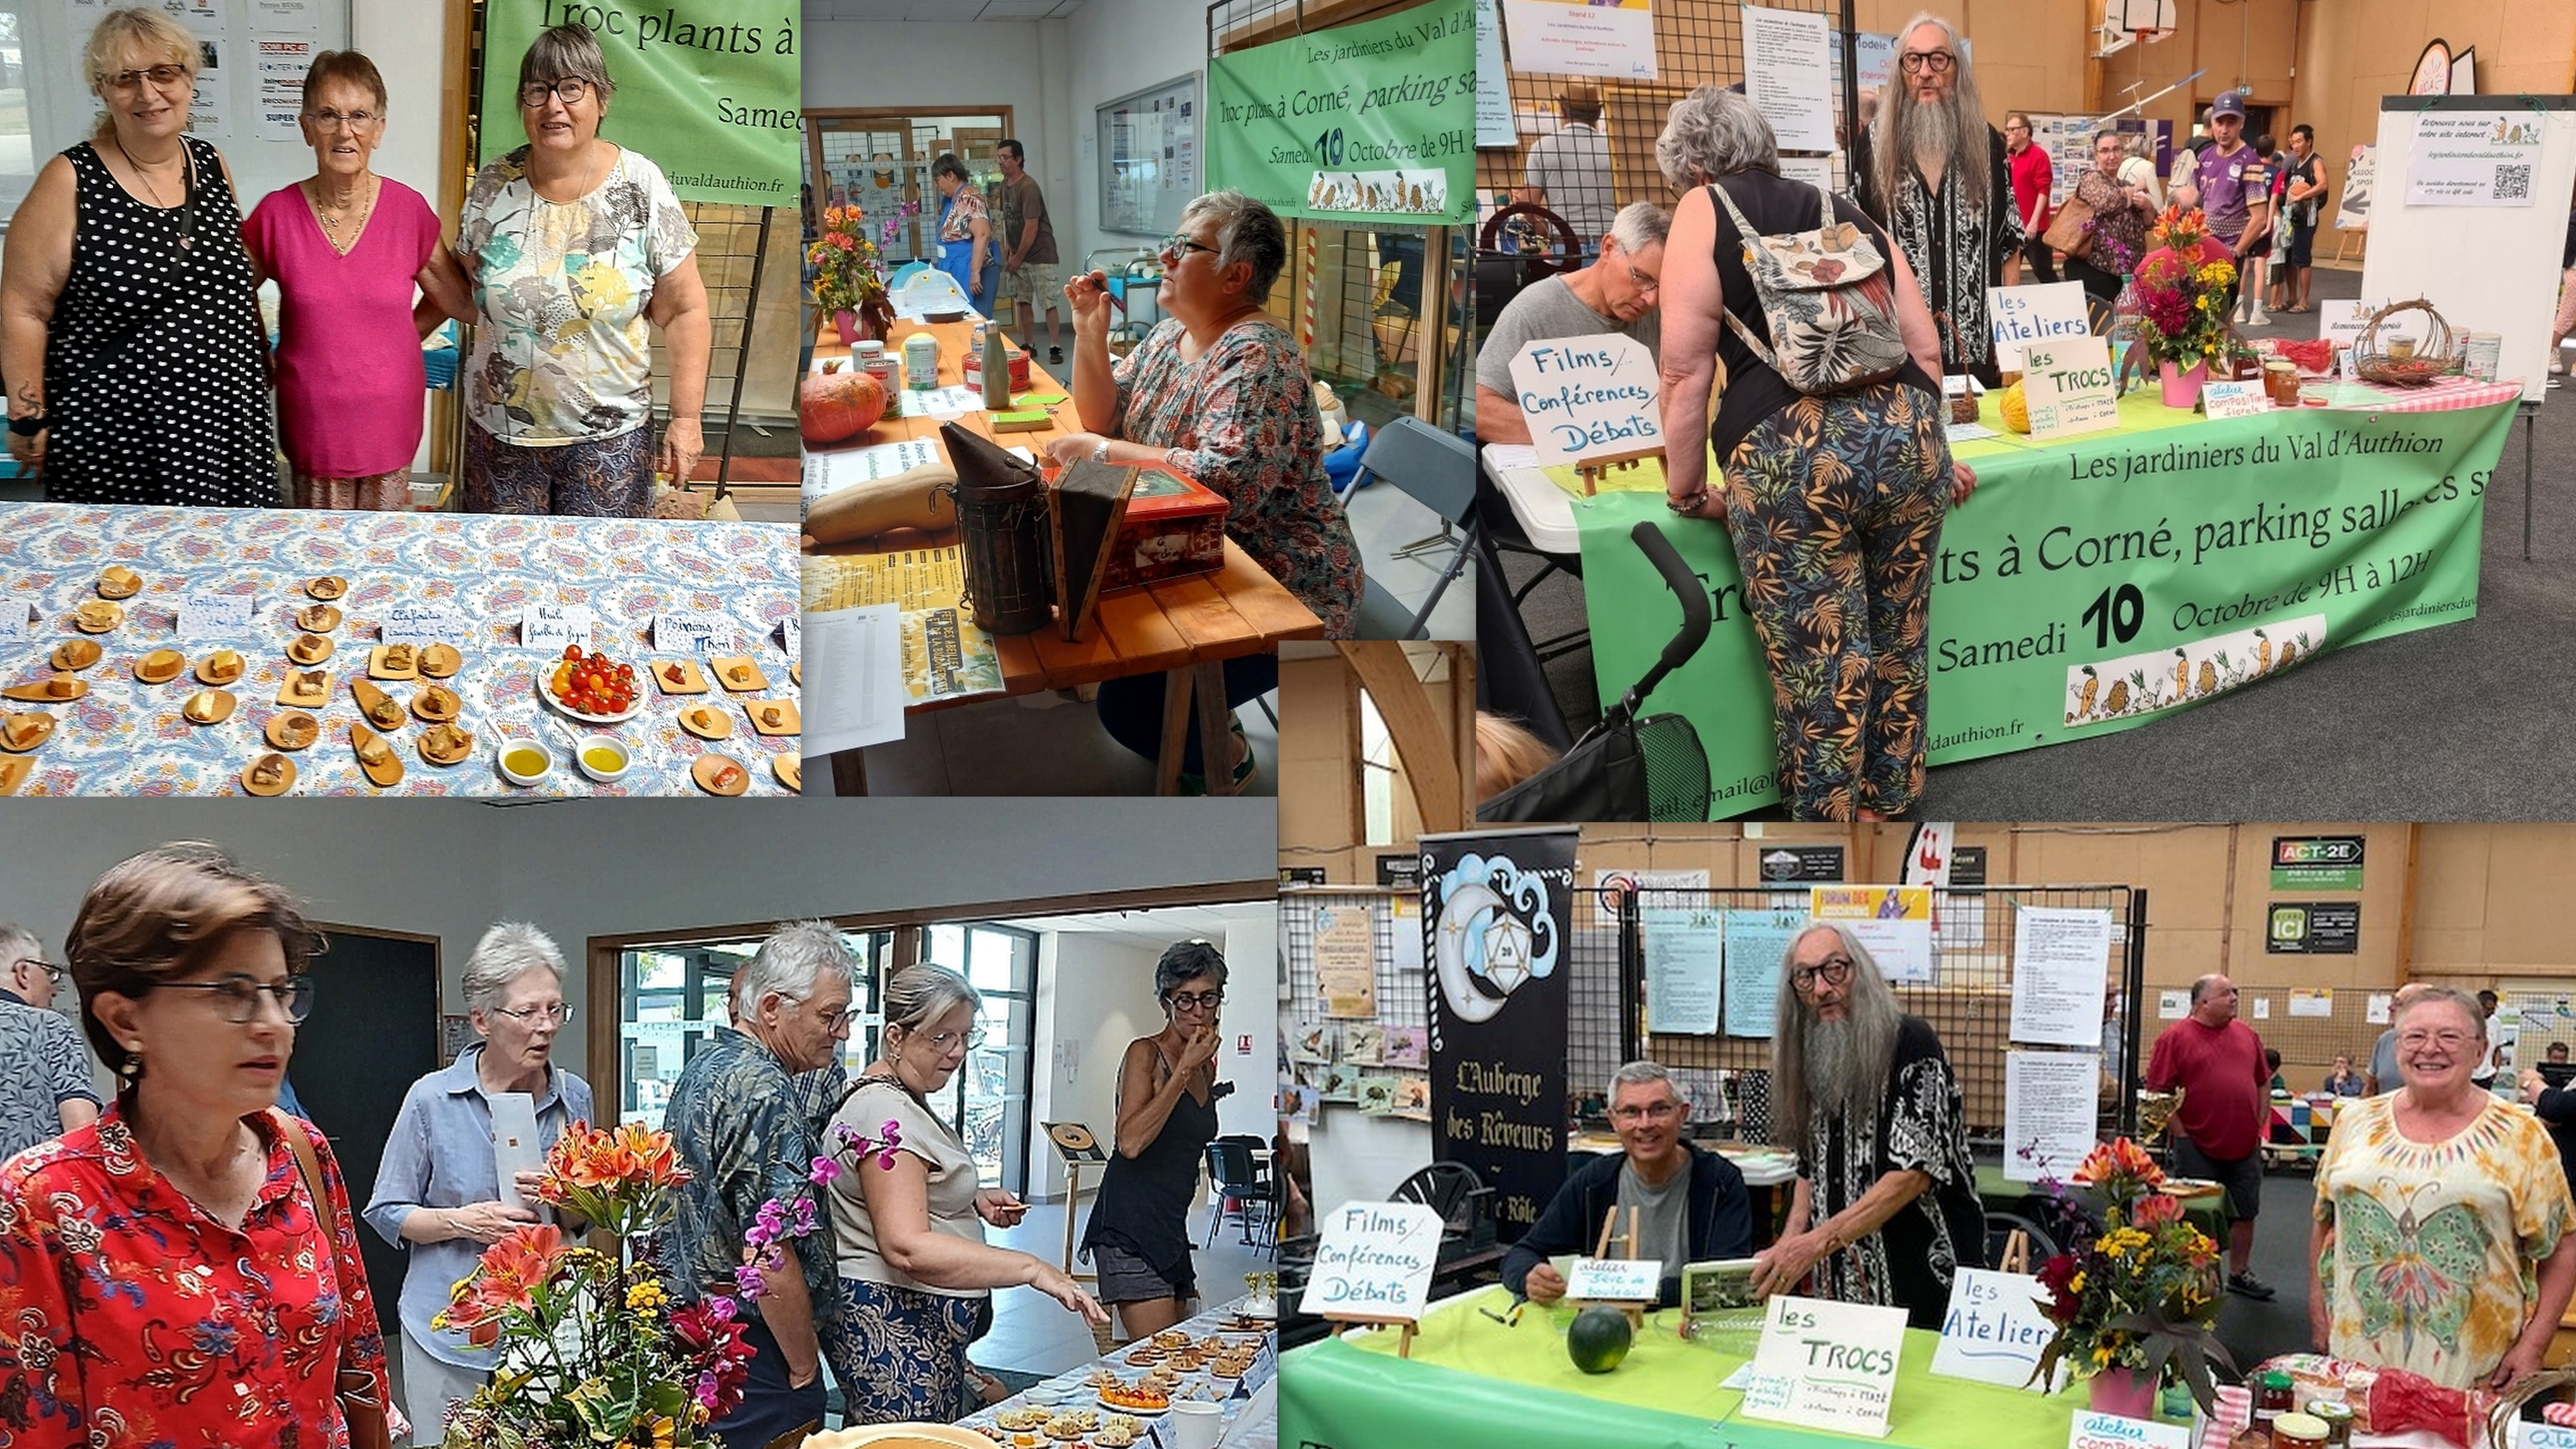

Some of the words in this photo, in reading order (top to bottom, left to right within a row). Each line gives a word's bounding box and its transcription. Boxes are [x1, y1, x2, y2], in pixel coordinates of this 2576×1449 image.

[637, 9, 763, 54] plants
[775, 18, 794, 54] à
[1307, 47, 1329, 63] Les
[1331, 39, 1393, 64] jardiniers
[1395, 31, 1415, 48] du
[1416, 19, 1445, 41] Val
[1278, 95, 1286, 118] à
[1293, 85, 1352, 117] Corné,
[1359, 74, 1452, 115] parking
[266, 114, 295, 122] SUPER
[2421, 119, 2456, 127] Retrouvez
[1314, 127, 1344, 167] 10
[1349, 139, 1416, 163] Octobre
[1421, 135, 1435, 158] de
[1439, 130, 1464, 156] 9H
[1997, 291, 2026, 310] les
[1994, 314, 2087, 343] Ateliers
[2028, 348, 2053, 369] les
[2049, 367, 2111, 393] TROCS
[1552, 414, 1658, 452] Débats
[2069, 452, 2118, 480] Les
[2122, 442, 2244, 483] jardiniers
[2251, 436, 2280, 464] du
[2287, 431, 2323, 461] Val
[2327, 429, 2444, 457] d'Authion
[1997, 534, 2022, 577] à
[2038, 517, 2182, 571] Corné,
[2193, 502, 2331, 566] parking
[1937, 622, 2066, 673] Samedi
[2082, 583, 2144, 649] 10
[2172, 592, 2279, 632] Octobre
[2283, 581, 2311, 606] de
[2318, 564, 2358, 599] 9H
[2367, 562, 2381, 590] à
[2389, 549, 2434, 586] 12H
[932, 638, 941, 647] LA
[943, 627, 955, 638] DES
[945, 640, 959, 671] ABEILLES
[2283, 844, 2350, 858] ACT-2E
[1456, 1061, 1543, 1106] L'Auberge
[1446, 1106, 1474, 1140] des
[1480, 1110, 1554, 1152] Rêveurs
[1323, 1277, 1407, 1305] Débats
[1966, 1274, 1999, 1299] les
[1779, 1300, 1816, 1328] les
[1942, 1307, 2051, 1346] Atelier
[1801, 1338, 1894, 1375] TROCS
[2083, 1416, 2146, 1441] atelier
